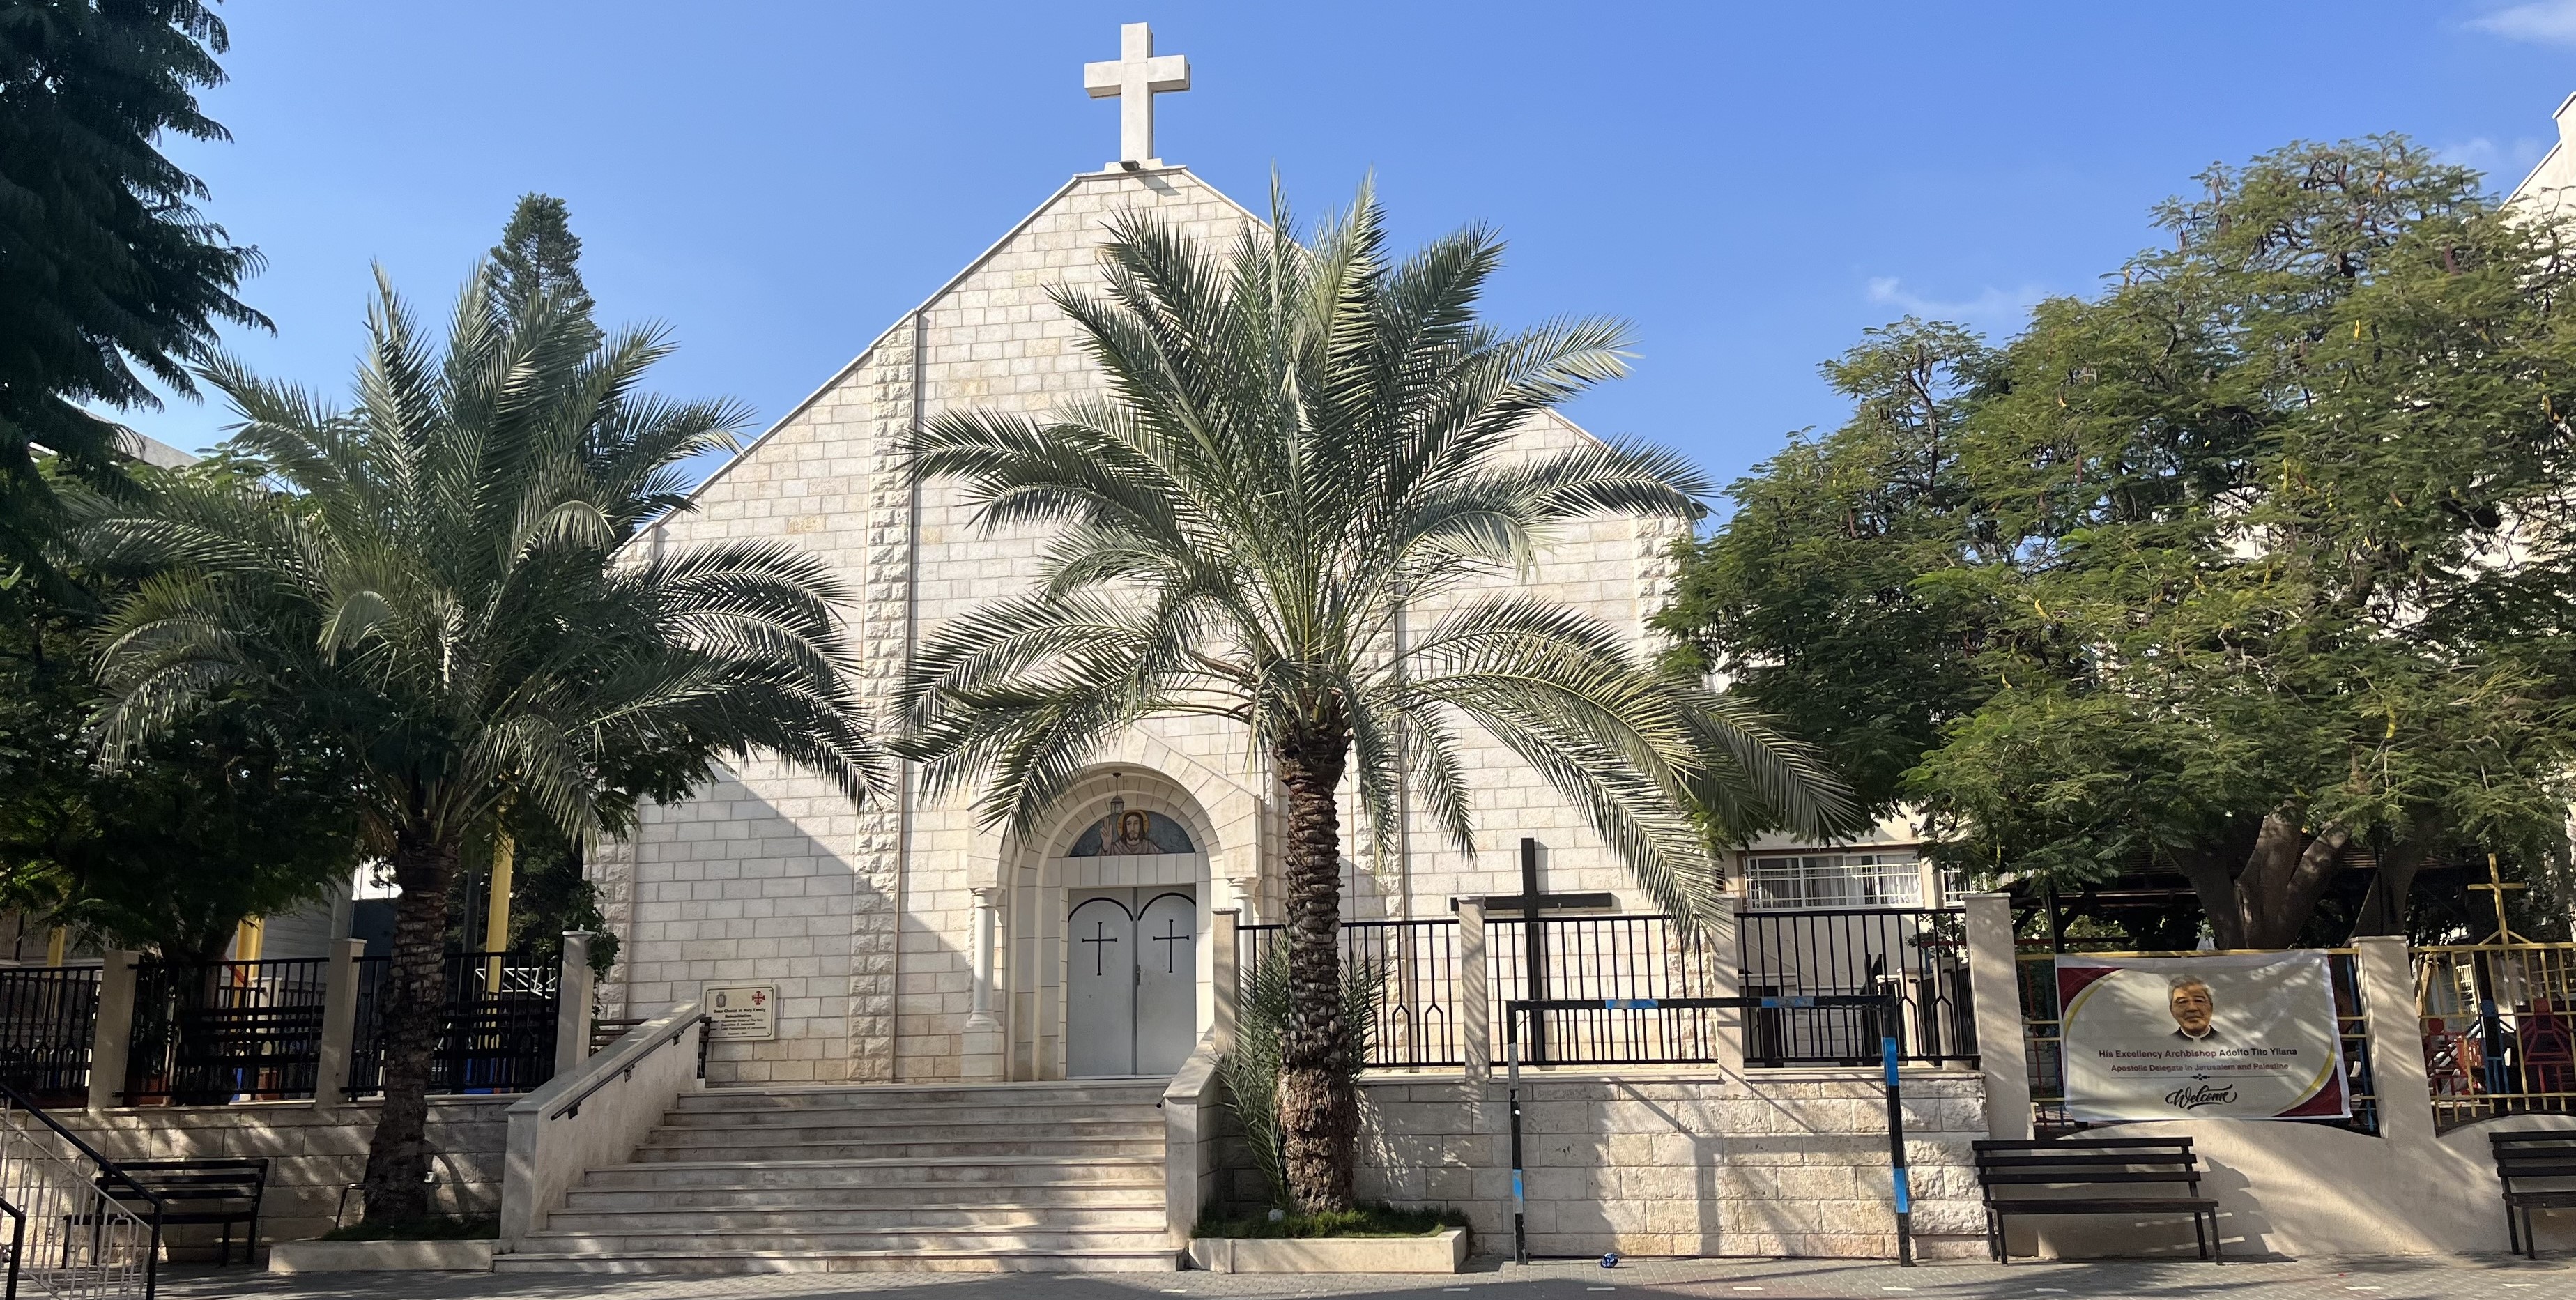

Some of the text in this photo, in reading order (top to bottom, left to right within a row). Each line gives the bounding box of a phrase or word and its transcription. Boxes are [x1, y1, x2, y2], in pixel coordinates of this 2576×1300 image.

[2099, 1047, 2297, 1060] His Excellency Archbishop Adolfo Tito Yllana
[2111, 1064, 2147, 1073] Apostolic
[2149, 1064, 2183, 1073] Delegate
[2165, 1083, 2237, 1110] Welcome
